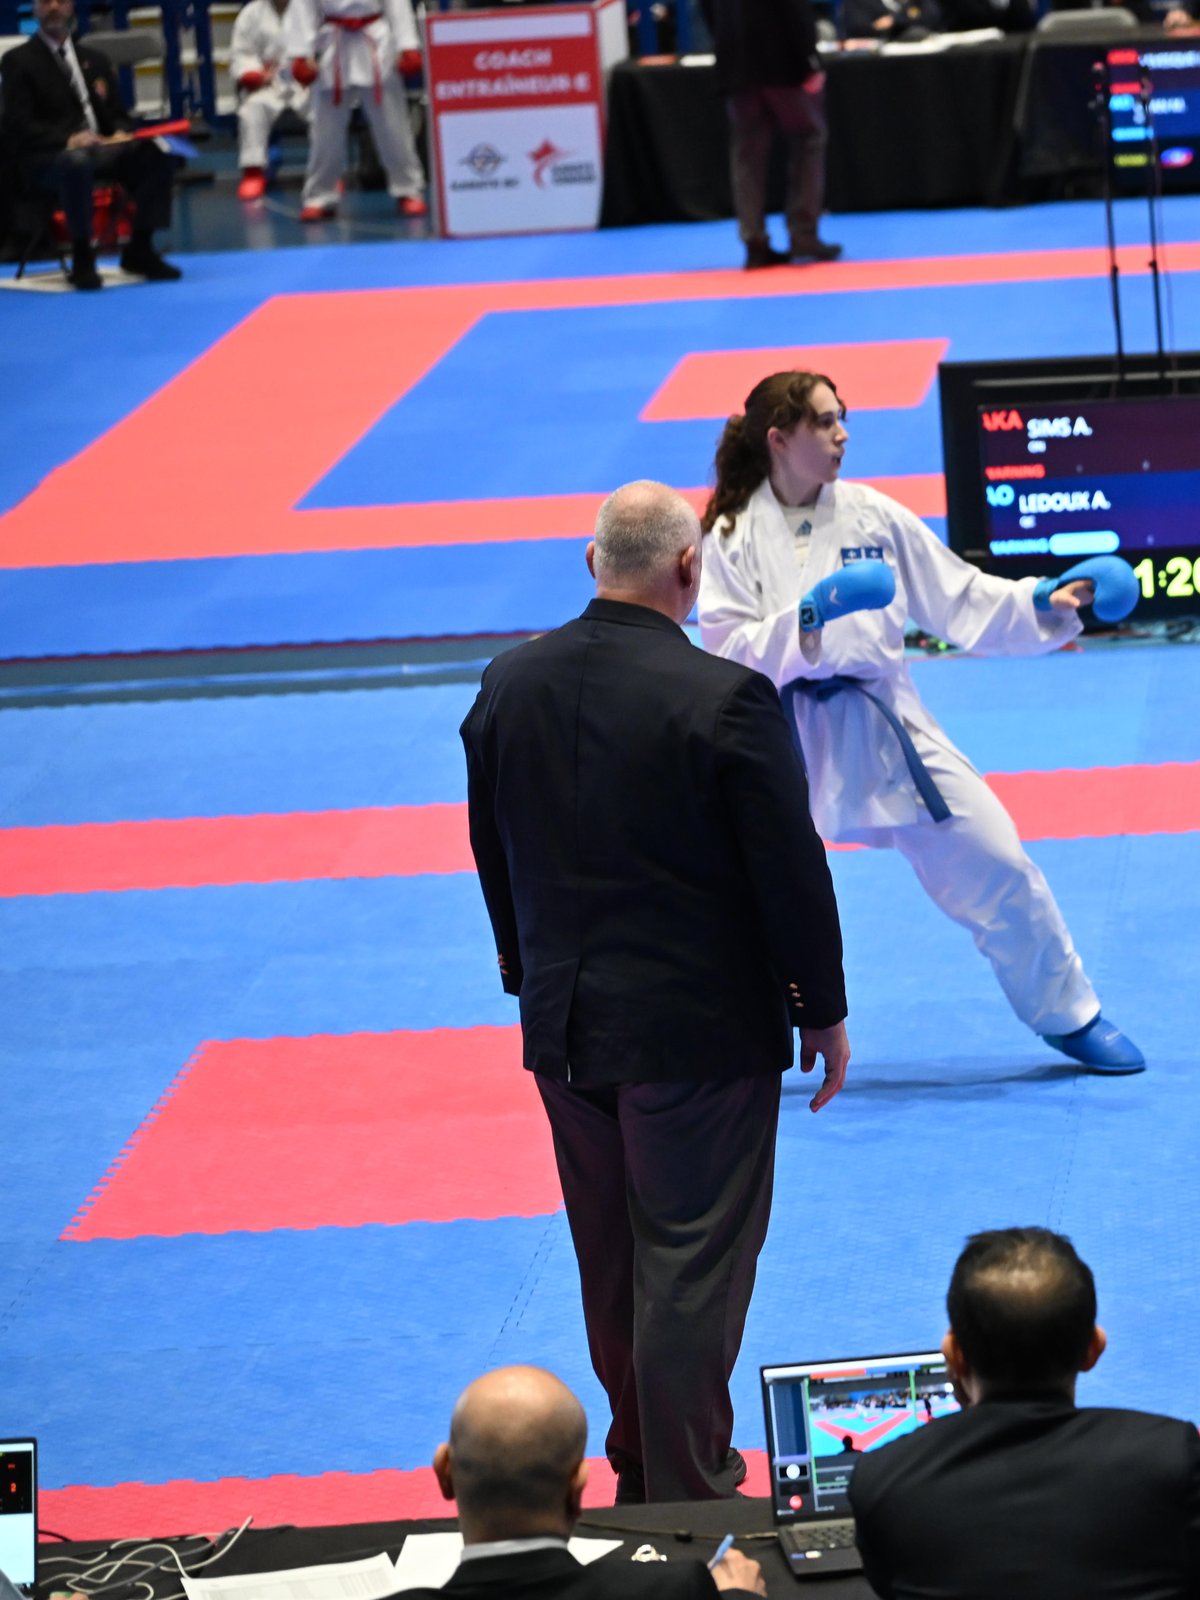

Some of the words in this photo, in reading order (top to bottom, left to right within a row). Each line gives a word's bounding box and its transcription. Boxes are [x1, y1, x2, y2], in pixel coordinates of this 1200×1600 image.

[474, 48, 553, 71] COACH
[1027, 416, 1072, 439] SIMS
[1072, 416, 1093, 437] A.
[1018, 491, 1090, 514] LEDOUX
[1091, 489, 1112, 510] A.
